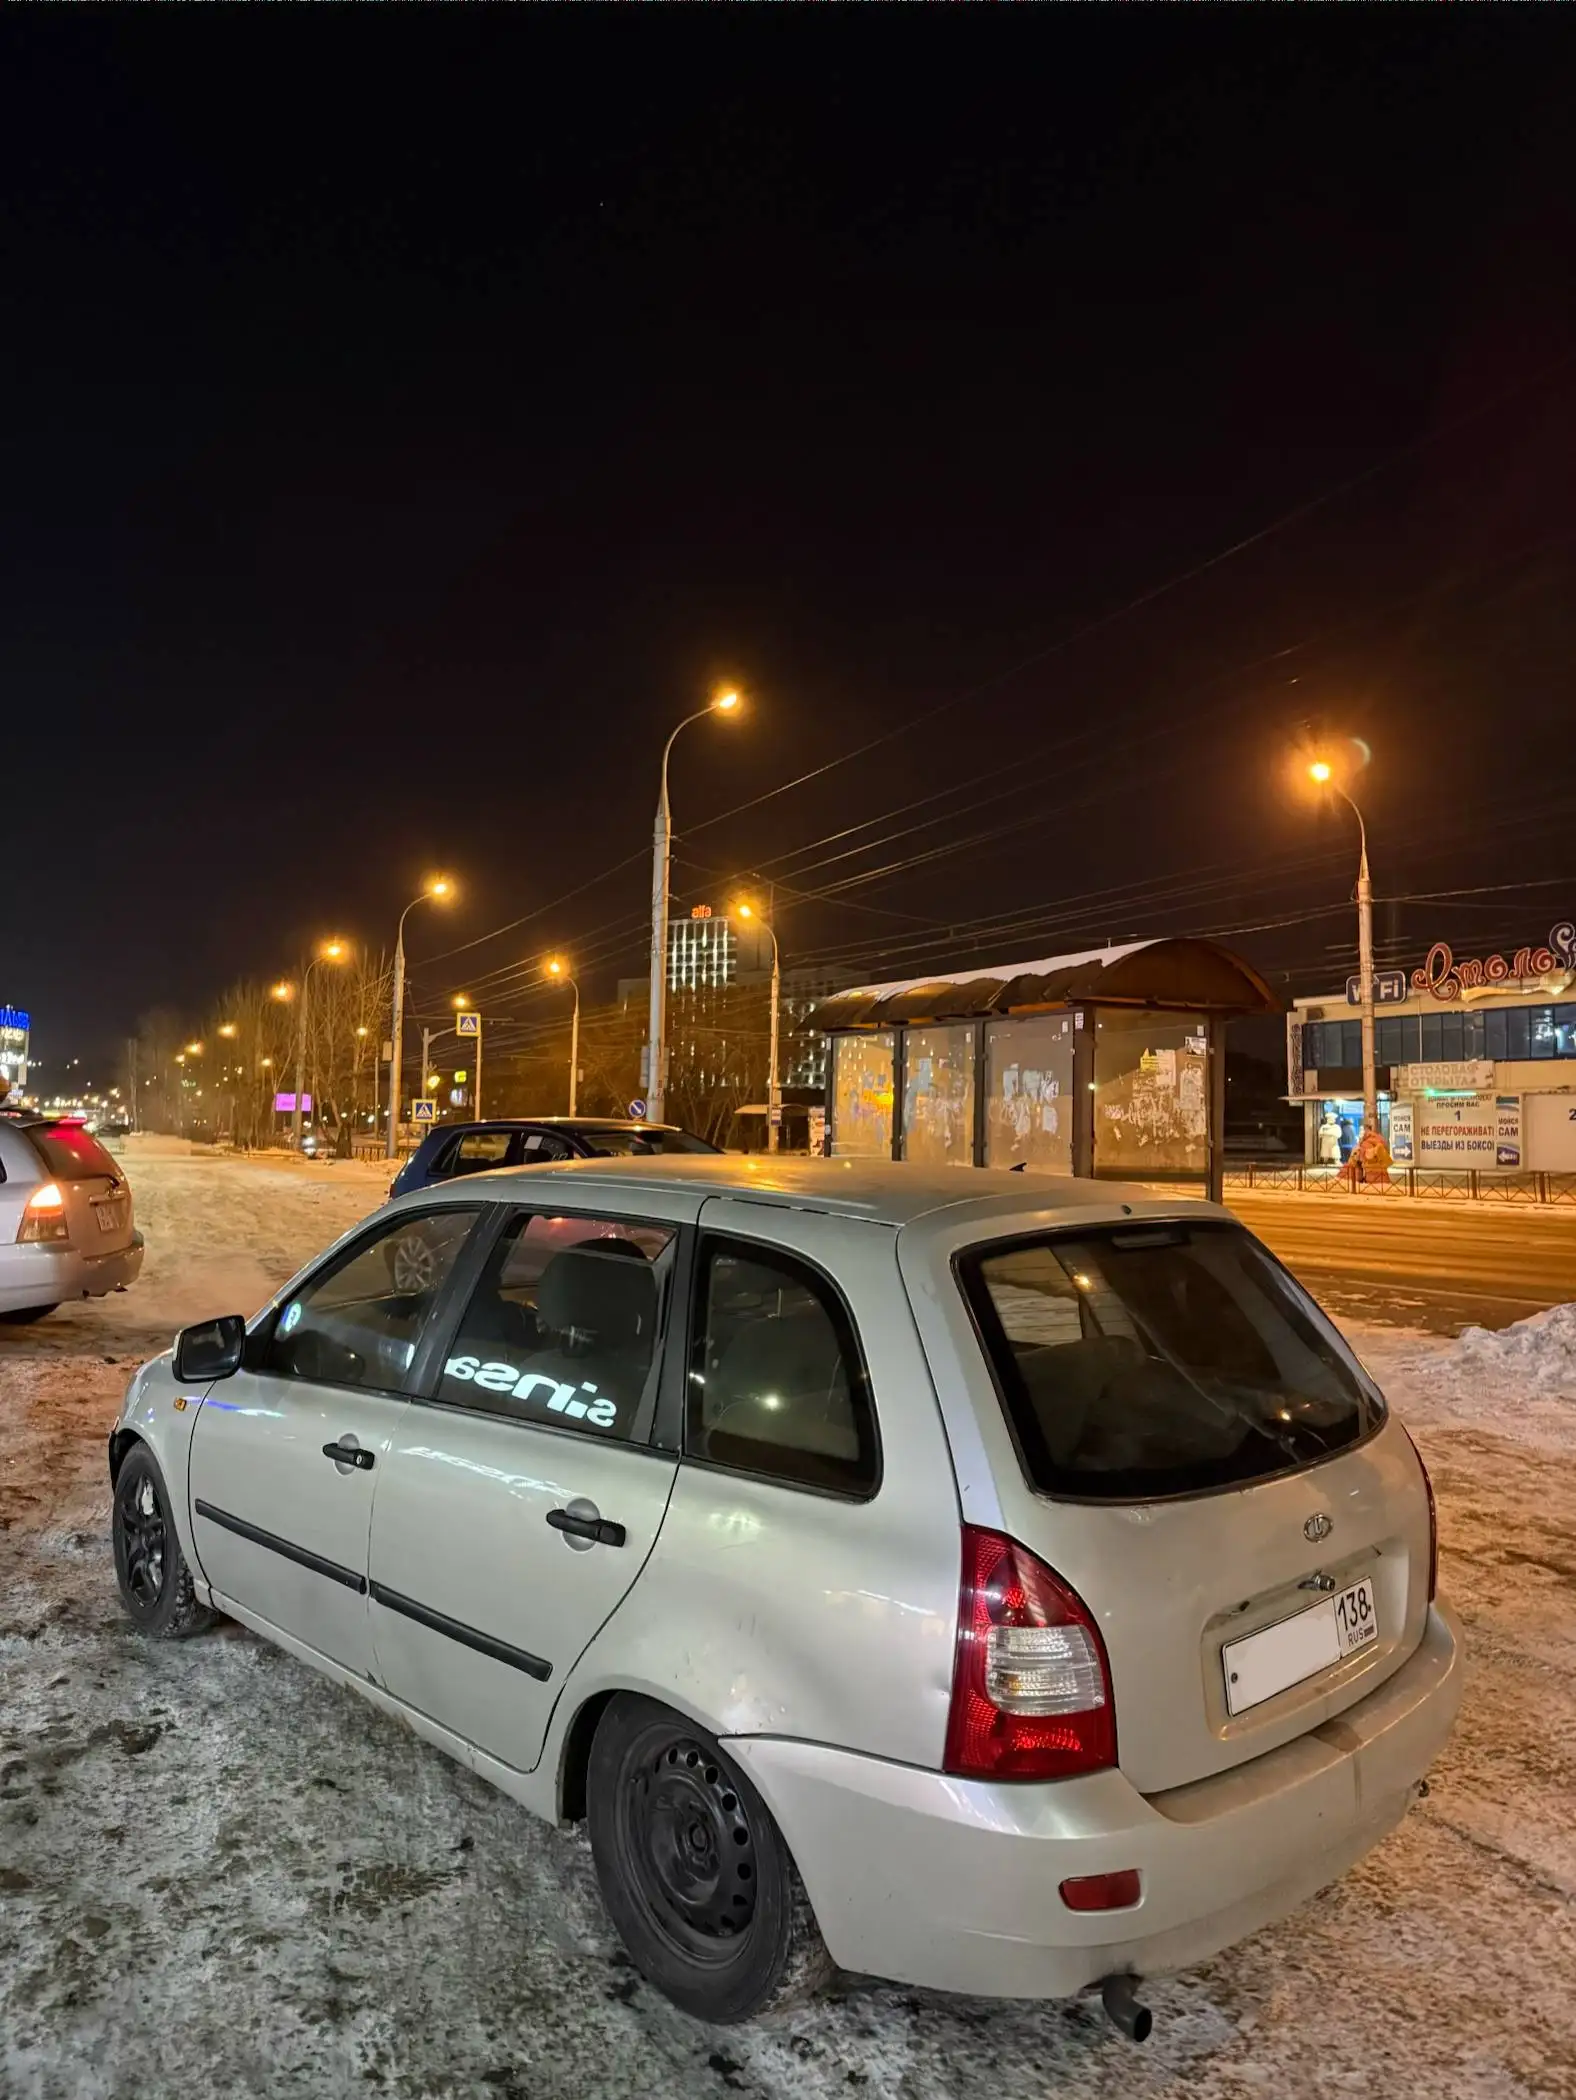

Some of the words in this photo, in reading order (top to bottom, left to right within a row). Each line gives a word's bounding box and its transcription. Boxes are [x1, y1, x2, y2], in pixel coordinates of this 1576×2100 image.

[1380, 979, 1399, 1000] Fi
[1455, 1110, 1461, 1121] 1
[1393, 1123, 1411, 1133] САМ
[1421, 1126, 1430, 1136] НЕ
[1498, 1126, 1519, 1137] САМ
[1421, 1139, 1453, 1151] ВЫЕЗДЫ
[1455, 1140, 1464, 1151] ИЗ
[1338, 1586, 1368, 1631] 138
[1347, 1627, 1364, 1647] RUS
